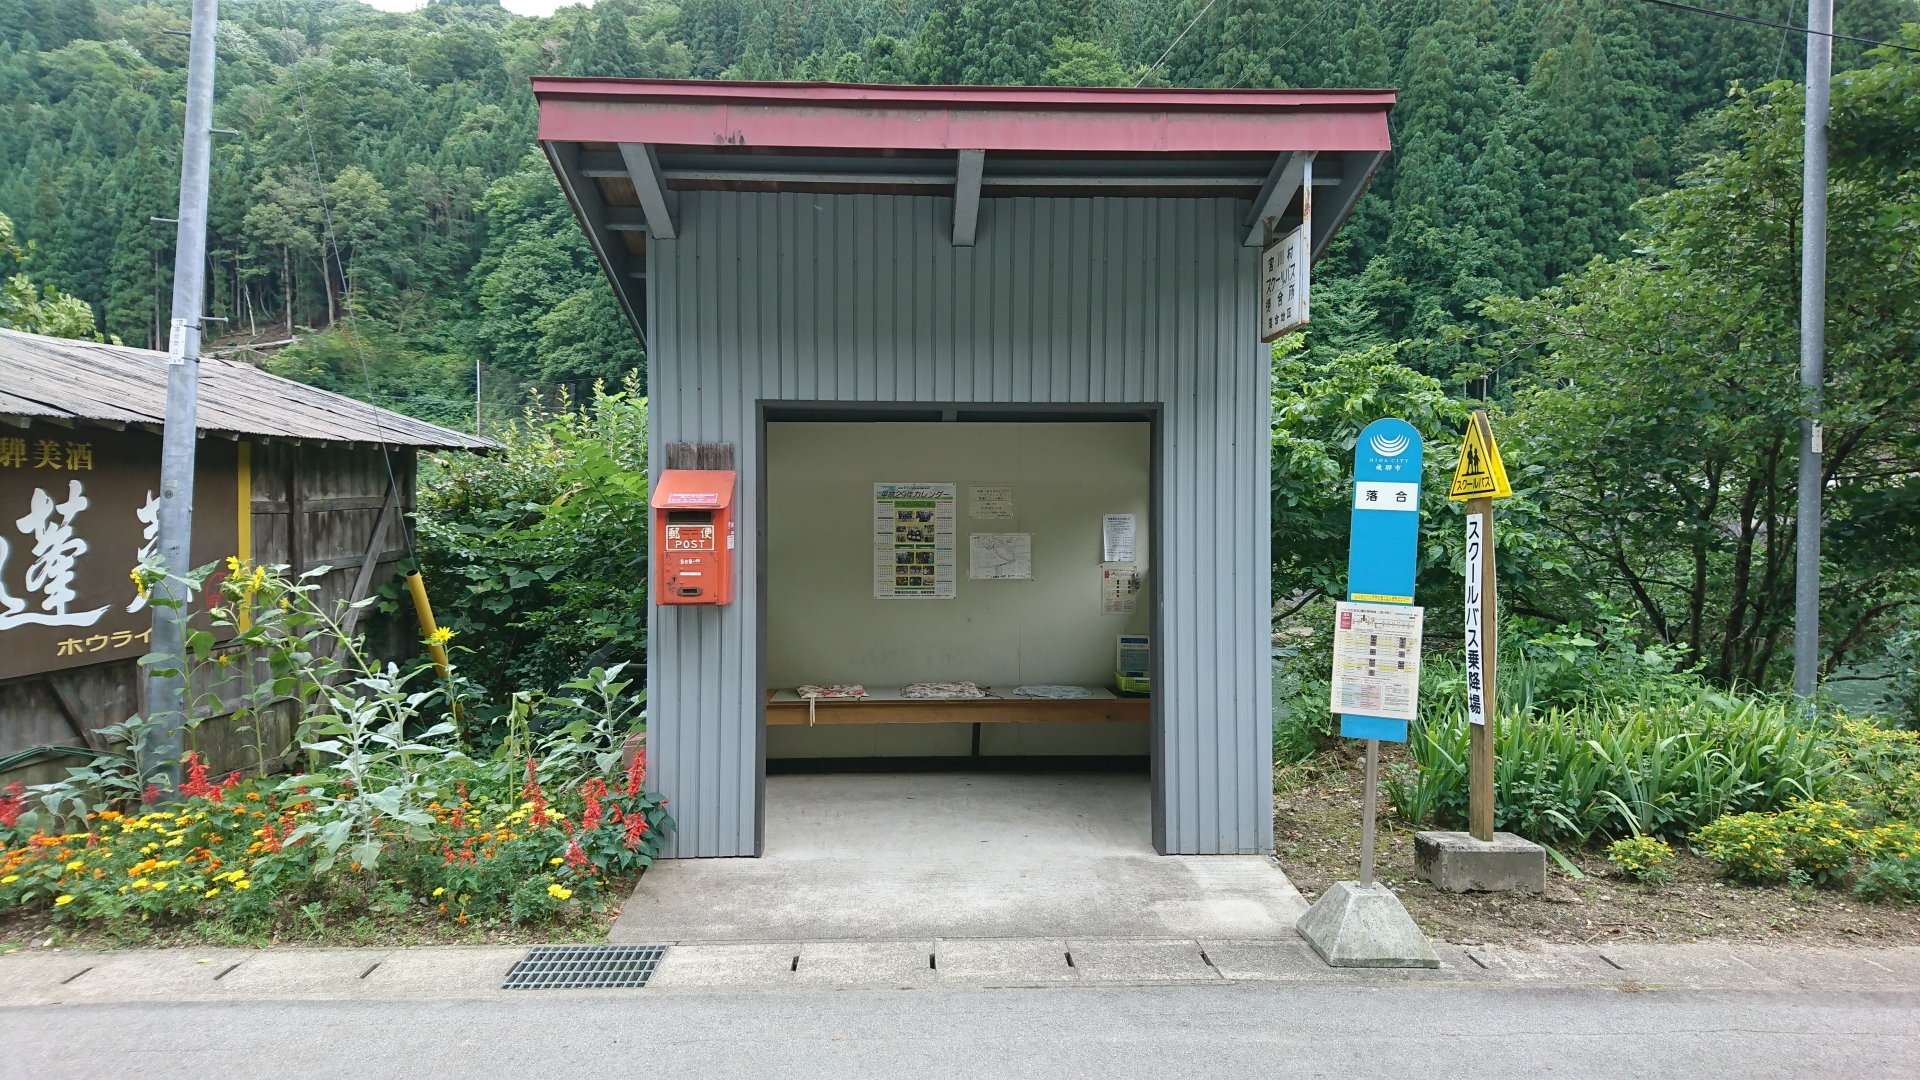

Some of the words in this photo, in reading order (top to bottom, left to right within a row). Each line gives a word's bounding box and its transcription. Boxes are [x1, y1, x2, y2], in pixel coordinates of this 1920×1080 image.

[1268, 244, 1294, 273] 宮川村
[1266, 263, 1296, 295] スクールバス
[1266, 284, 1296, 313] 待合所
[1366, 490, 1408, 503] 落合
[1456, 476, 1491, 491] スクールバス
[675, 540, 705, 549] POST
[1466, 520, 1481, 715] スクールバス乗降場
